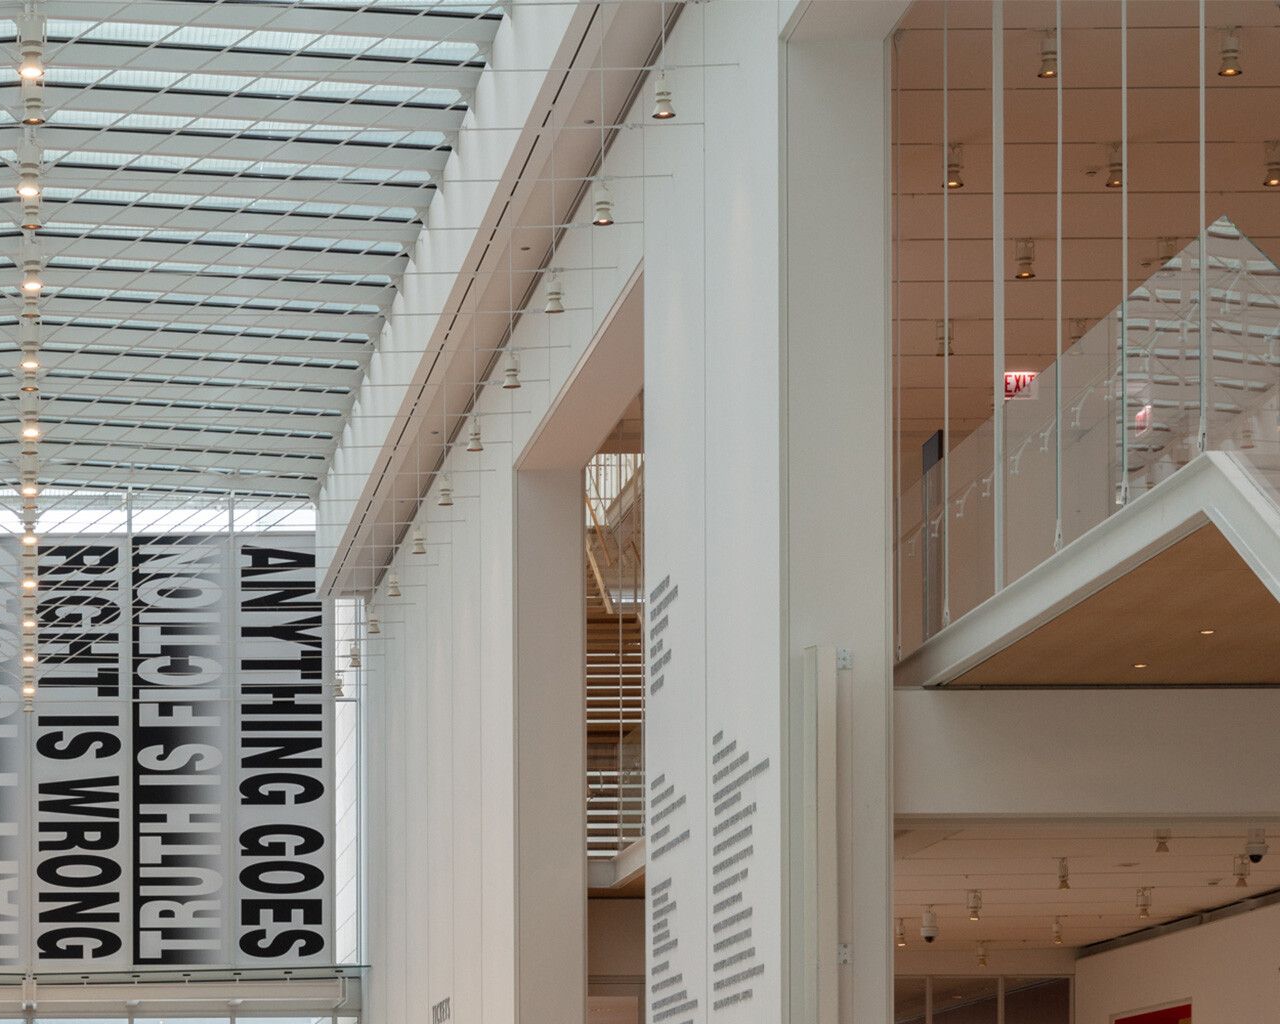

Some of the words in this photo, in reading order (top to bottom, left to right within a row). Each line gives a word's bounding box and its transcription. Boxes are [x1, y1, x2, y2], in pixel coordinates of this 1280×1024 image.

[1005, 375, 1035, 393] EXIT
[36, 545, 121, 697] RIGHT
[137, 545, 223, 727] FICTION
[239, 545, 325, 805] ANYTHING
[36, 715, 122, 760] IS
[137, 743, 223, 786] IS
[36, 775, 122, 959] WRONG
[139, 803, 223, 959] TRUTH
[239, 823, 325, 958] GOES
